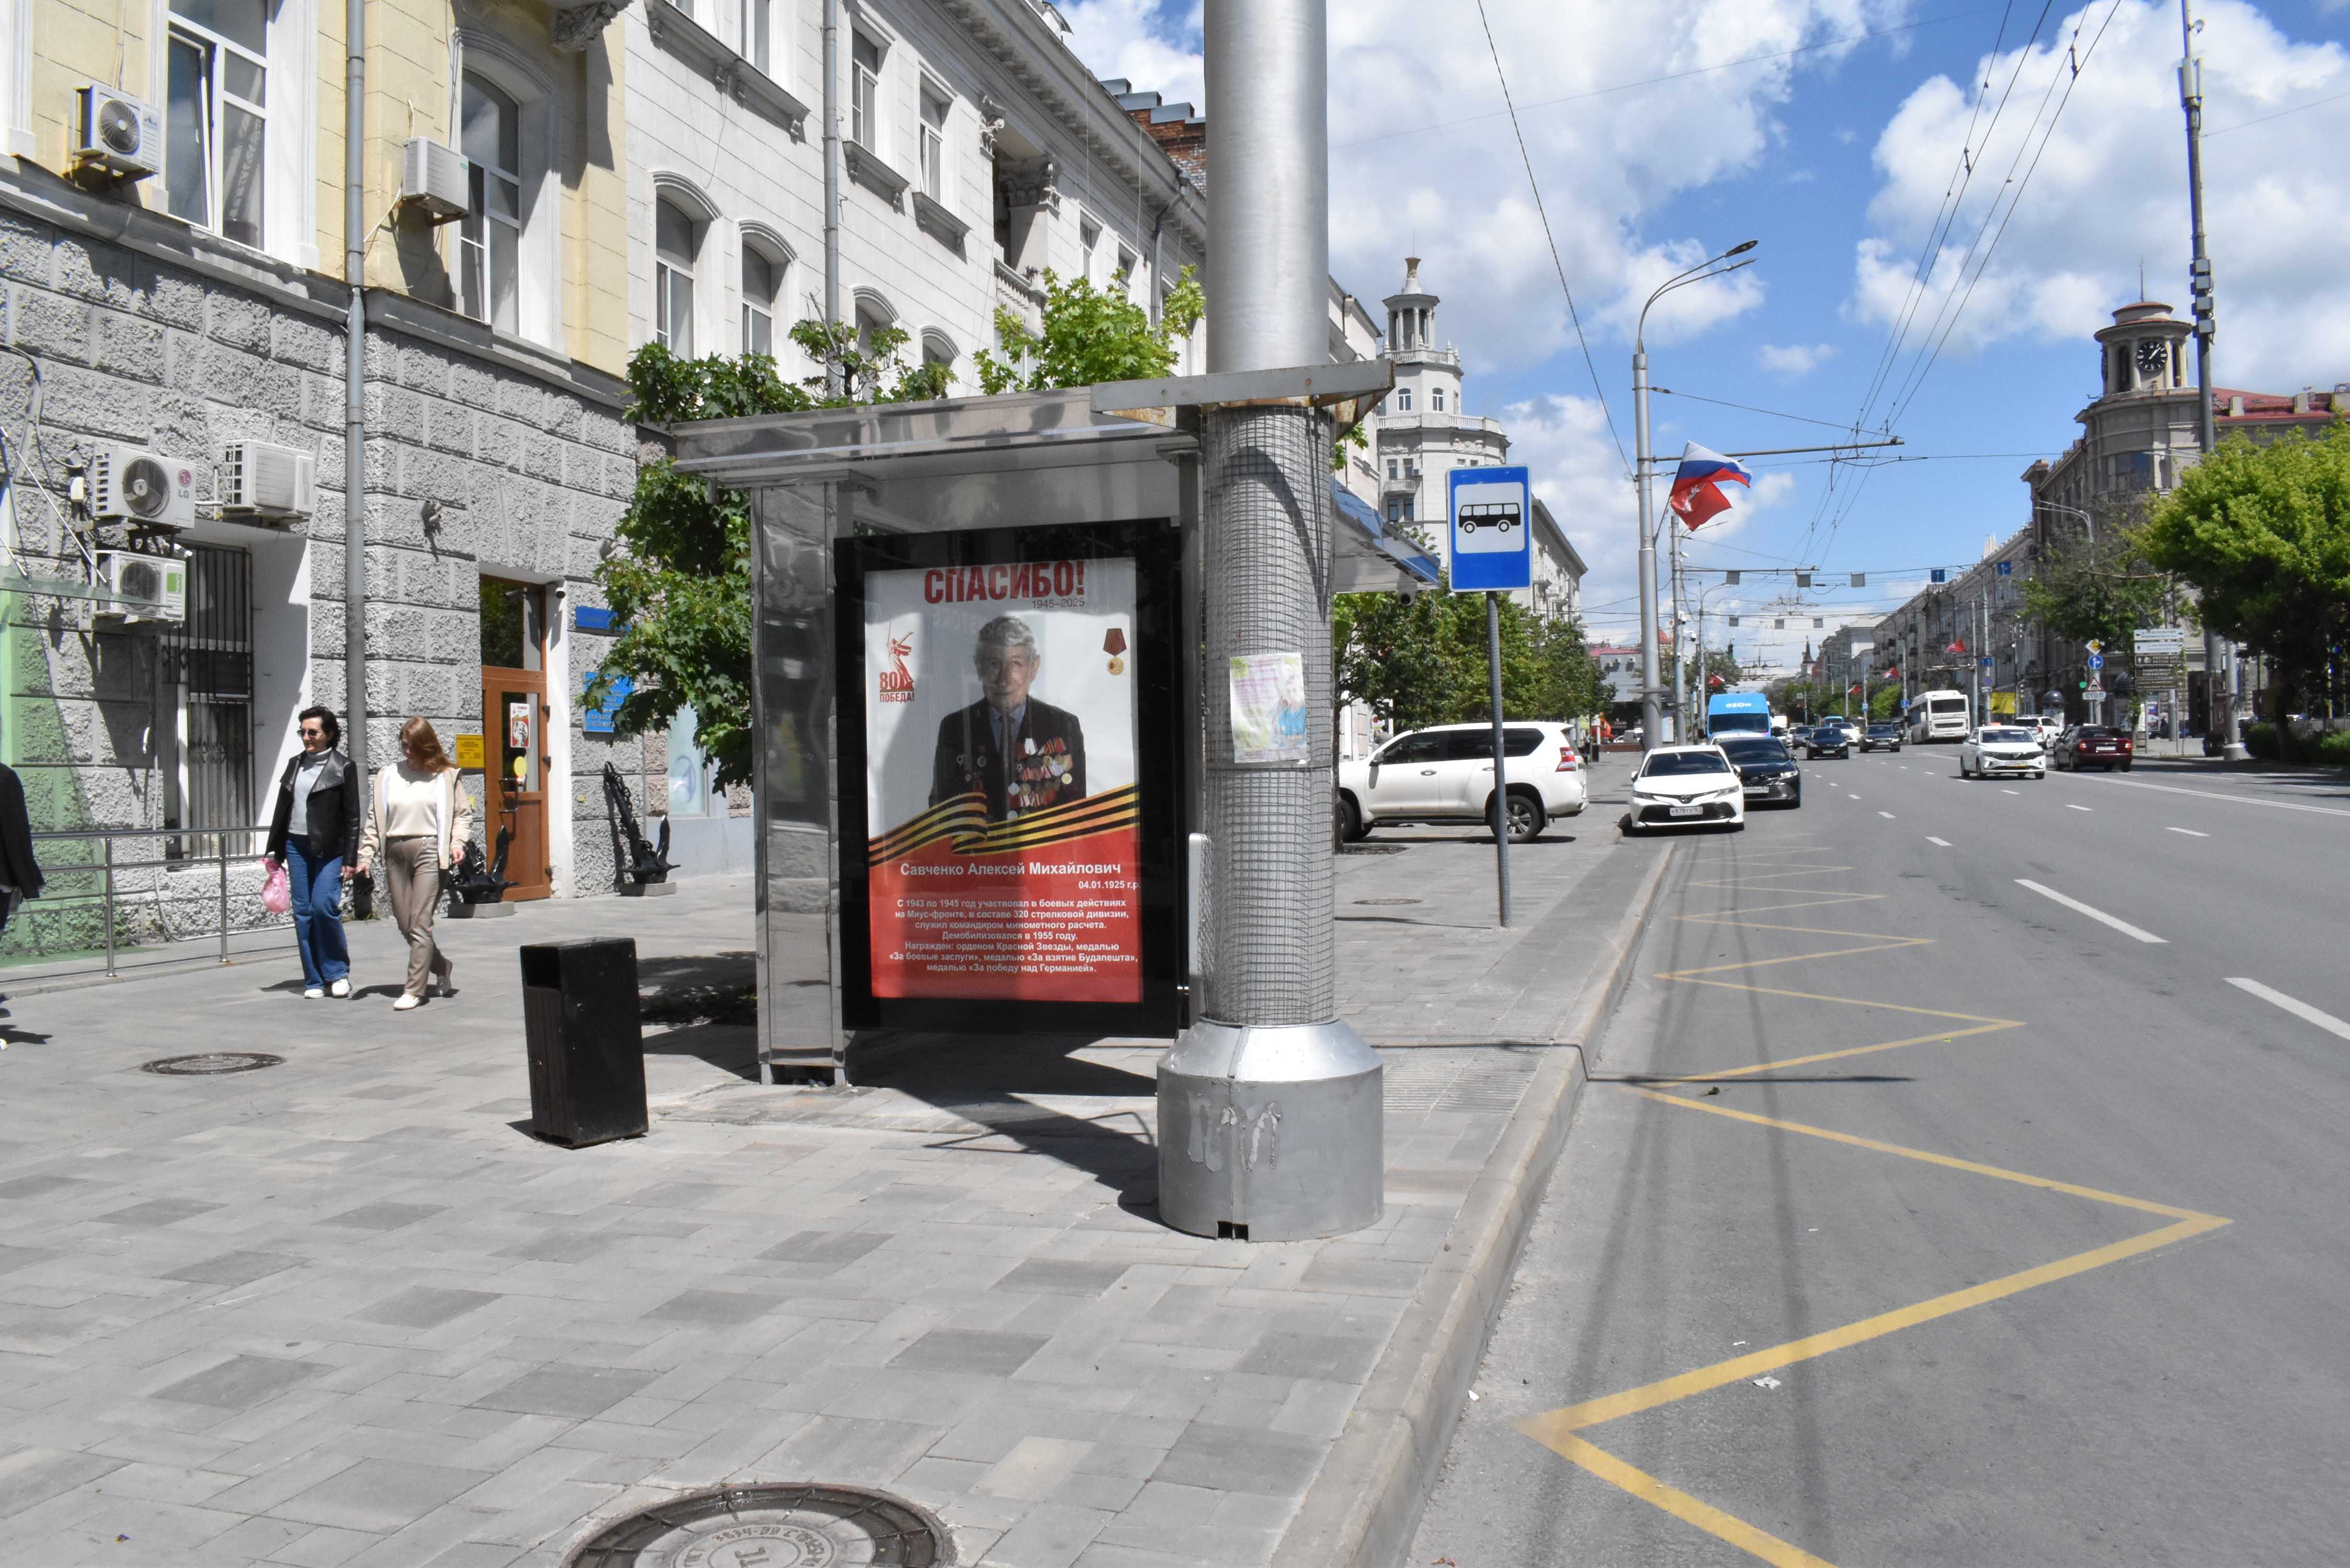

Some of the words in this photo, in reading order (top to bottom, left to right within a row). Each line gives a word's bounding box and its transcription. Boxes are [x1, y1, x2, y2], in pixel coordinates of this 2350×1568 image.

[178, 489, 189, 499] LG
[924, 560, 1085, 604] СПАСИБО!
[879, 671, 898, 691] 80
[880, 692, 915, 703] ПОБЕДА!
[900, 863, 964, 875] Савченко
[967, 862, 1025, 875] Алексей
[1030, 861, 1121, 874] Михайлович
[1078, 881, 1125, 889] 04.01.1925
[978, 901, 1029, 909] участвовал
[1077, 899, 1126, 908] действиях
[907, 910, 967, 919] Миус-фронте,
[1031, 910, 1084, 919] стрелковой
[1086, 911, 1129, 919] дивизии,
[915, 923, 947, 931] служил
[950, 923, 1004, 931] командиром
[1068, 922, 1107, 930] расчета.
[942, 931, 1022, 940] Демобилизовался
[905, 942, 954, 951] Награжден:
[996, 942, 1034, 951] Красной
[1036, 942, 1074, 951] Звезды,
[940, 954, 982, 962] заслуги»,
[1078, 953, 1138, 962] Будапешта»,
[986, 965, 1018, 973] победу
[1040, 964, 1097, 973] Германией».
